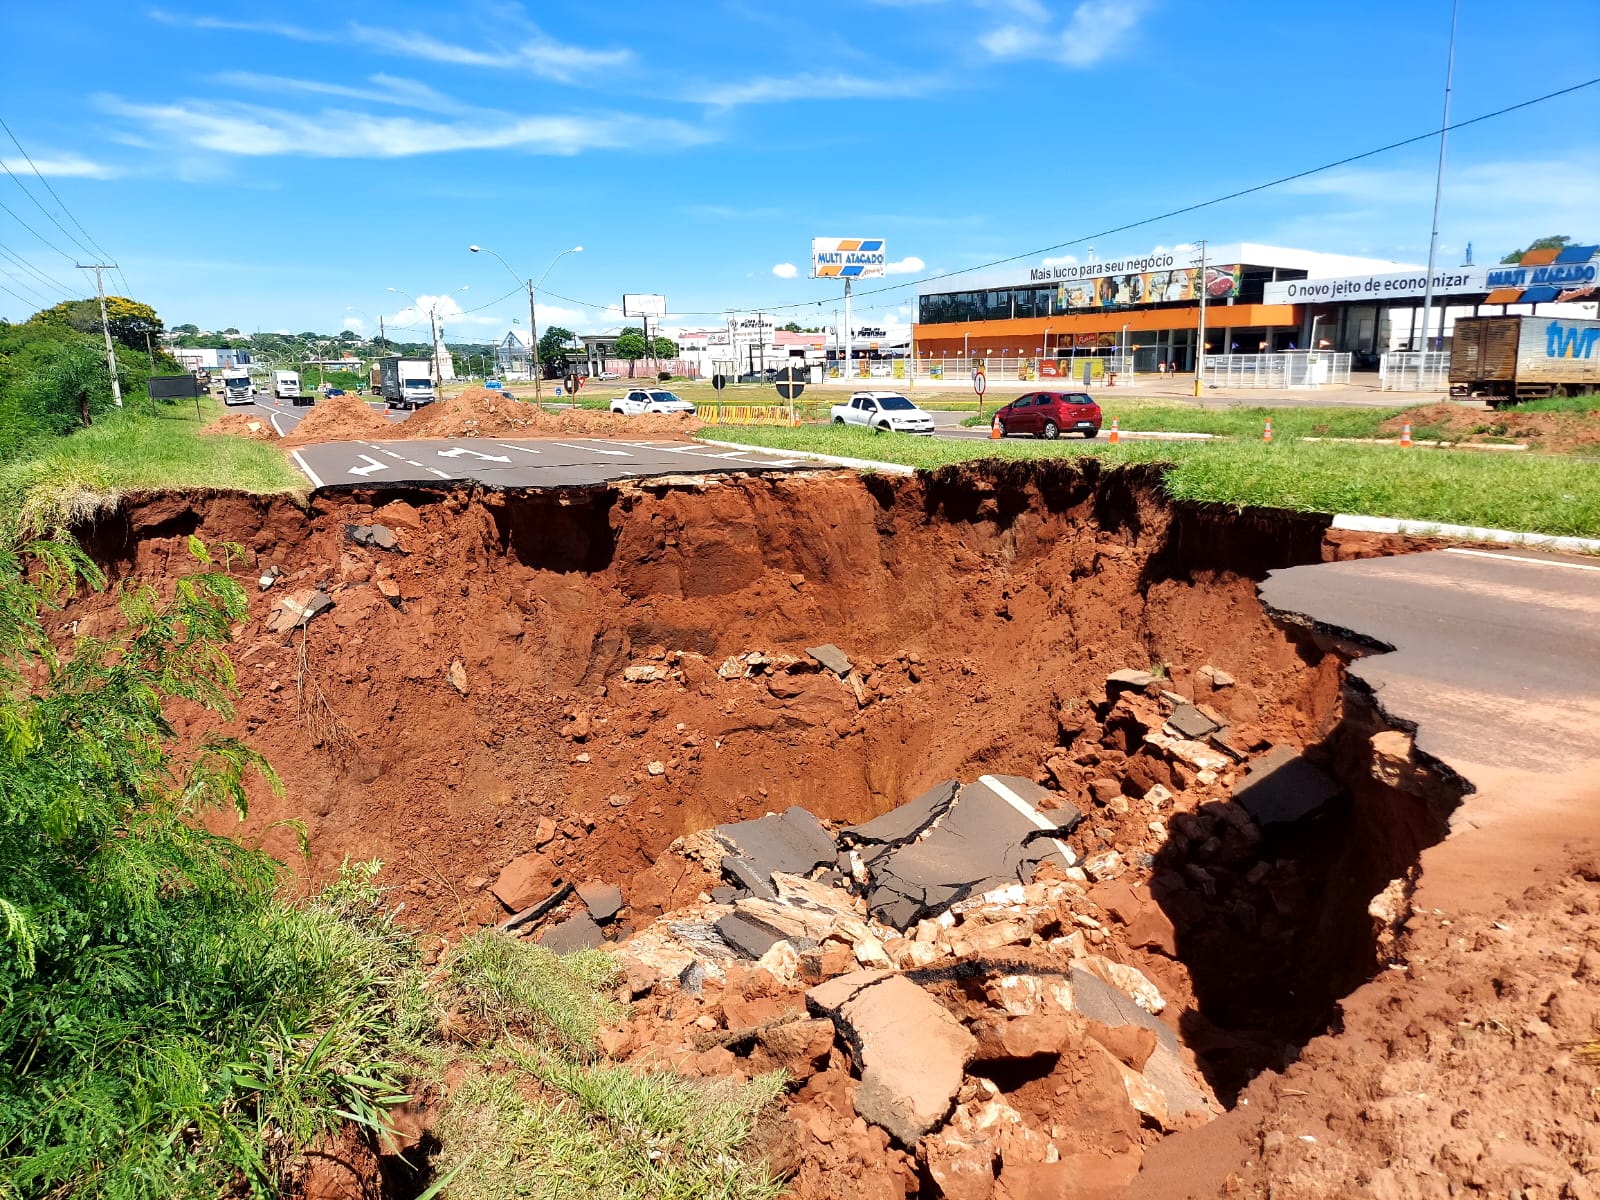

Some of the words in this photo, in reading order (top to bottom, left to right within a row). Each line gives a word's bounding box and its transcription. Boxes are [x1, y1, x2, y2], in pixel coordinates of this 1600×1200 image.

[817, 253, 842, 264] MULTI
[845, 253, 884, 264] ATACADO
[1030, 267, 1051, 281] Mais
[1053, 265, 1077, 278] lucro
[1080, 264, 1102, 277] para
[1105, 261, 1124, 273] seu
[1126, 253, 1174, 272] negócio
[1287, 284, 1297, 297] O
[1300, 284, 1329, 296] novo
[1331, 279, 1361, 298] jeito
[1364, 277, 1381, 292] de
[1384, 272, 1470, 291] economizar
[1487, 269, 1527, 286] MULTI
[1530, 265, 1596, 284] ATACADO
